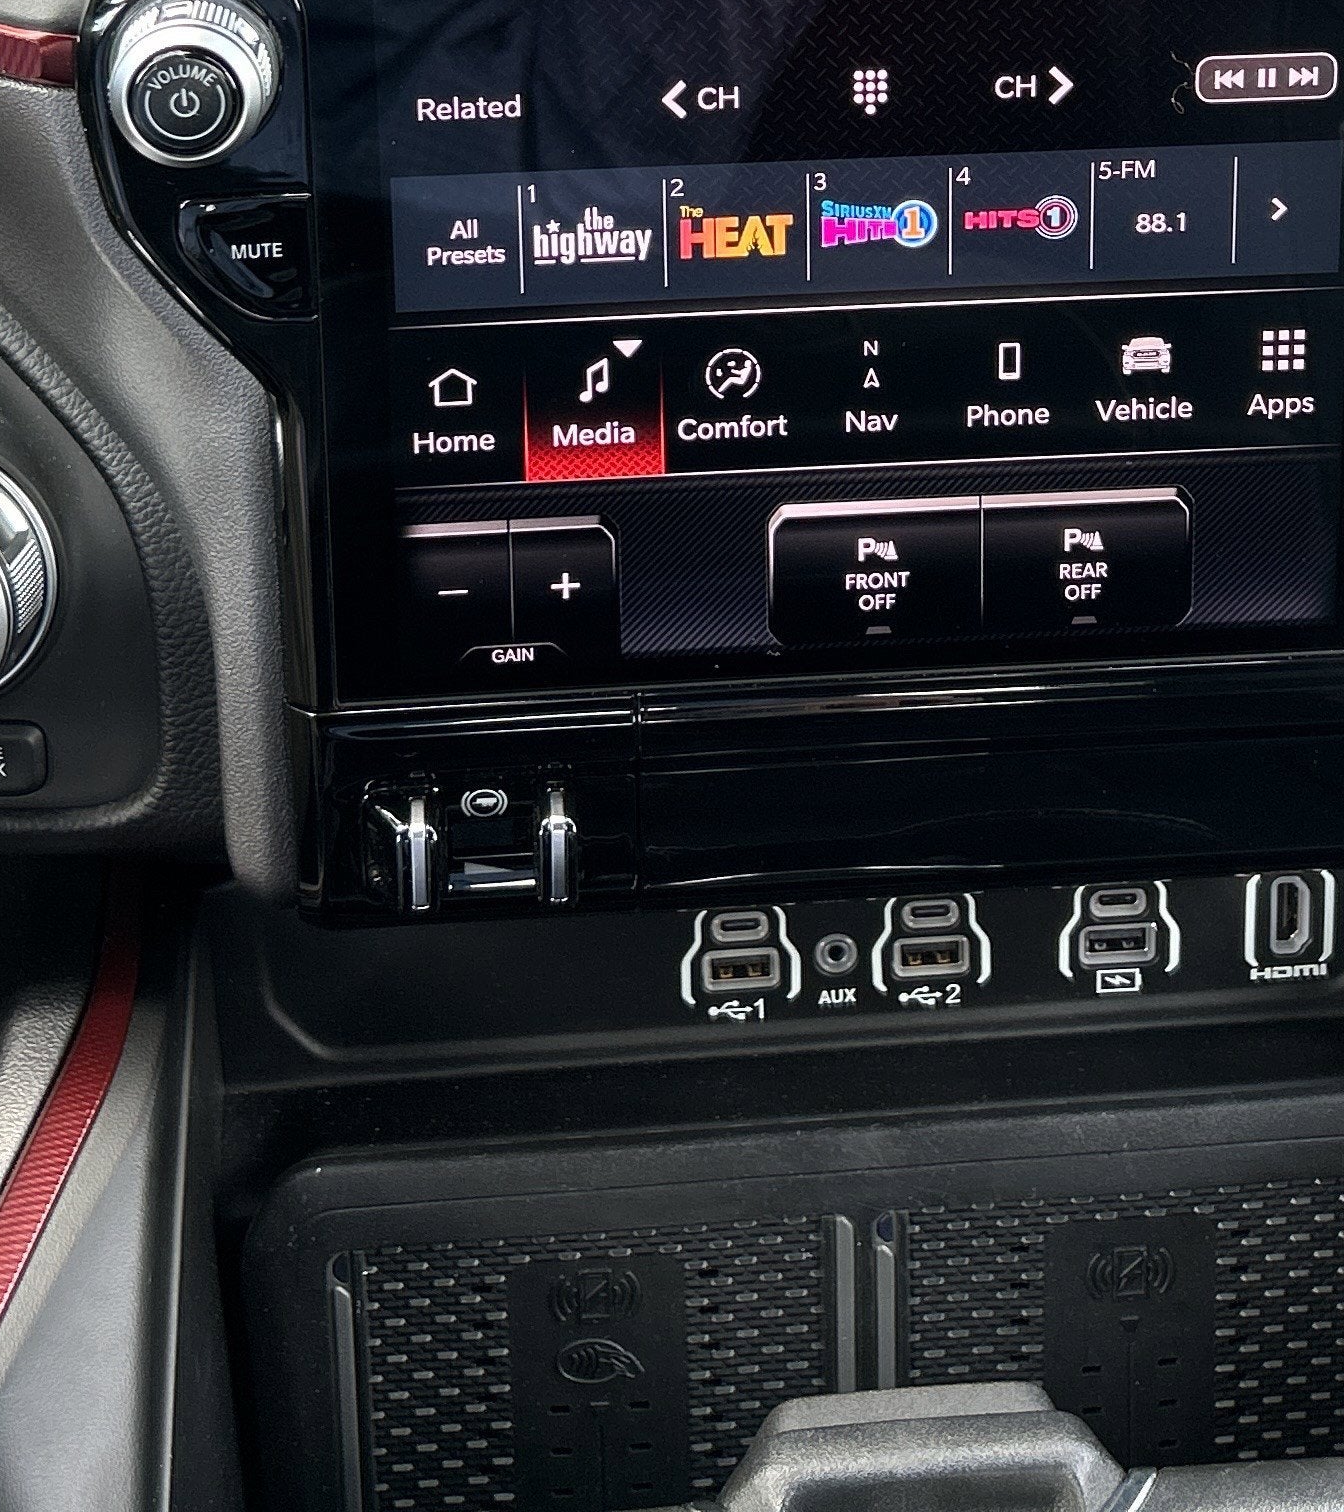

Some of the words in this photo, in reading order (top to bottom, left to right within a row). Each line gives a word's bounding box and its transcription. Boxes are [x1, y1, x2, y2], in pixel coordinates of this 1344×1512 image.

[147, 64, 219, 90] VOLUME
[994, 74, 1037, 99] CH
[417, 93, 522, 122] Related
[697, 85, 740, 110] CH
[955, 166, 972, 186] 4
[1098, 159, 1156, 180] 5-FM
[669, 178, 685, 197] 2
[813, 172, 827, 191] 3
[527, 184, 536, 203] 1
[585, 207, 613, 231] the
[679, 206, 703, 218] The
[964, 208, 1038, 230] HITS
[1134, 211, 1186, 234] 88.1
[449, 218, 479, 240] All
[678, 215, 793, 259] HEAT
[230, 242, 284, 260] MUTE
[534, 222, 652, 265] highway
[427, 245, 506, 266] Presets
[966, 403, 1050, 428] Phone
[1094, 395, 1193, 422] Vehicle
[1246, 393, 1315, 420] Apps
[677, 414, 788, 441] Comfort
[845, 410, 899, 433] Nav
[413, 431, 496, 455] Home
[552, 422, 636, 446] Media
[845, 570, 911, 591] FRONT
[1059, 561, 1108, 580] REAR
[858, 593, 897, 611] OFF
[1064, 583, 1102, 601] OFF
[491, 648, 535, 664] GAIN
[1250, 964, 1328, 980] HDMI
[817, 987, 857, 1005] AUX
[944, 984, 964, 1006] 2
